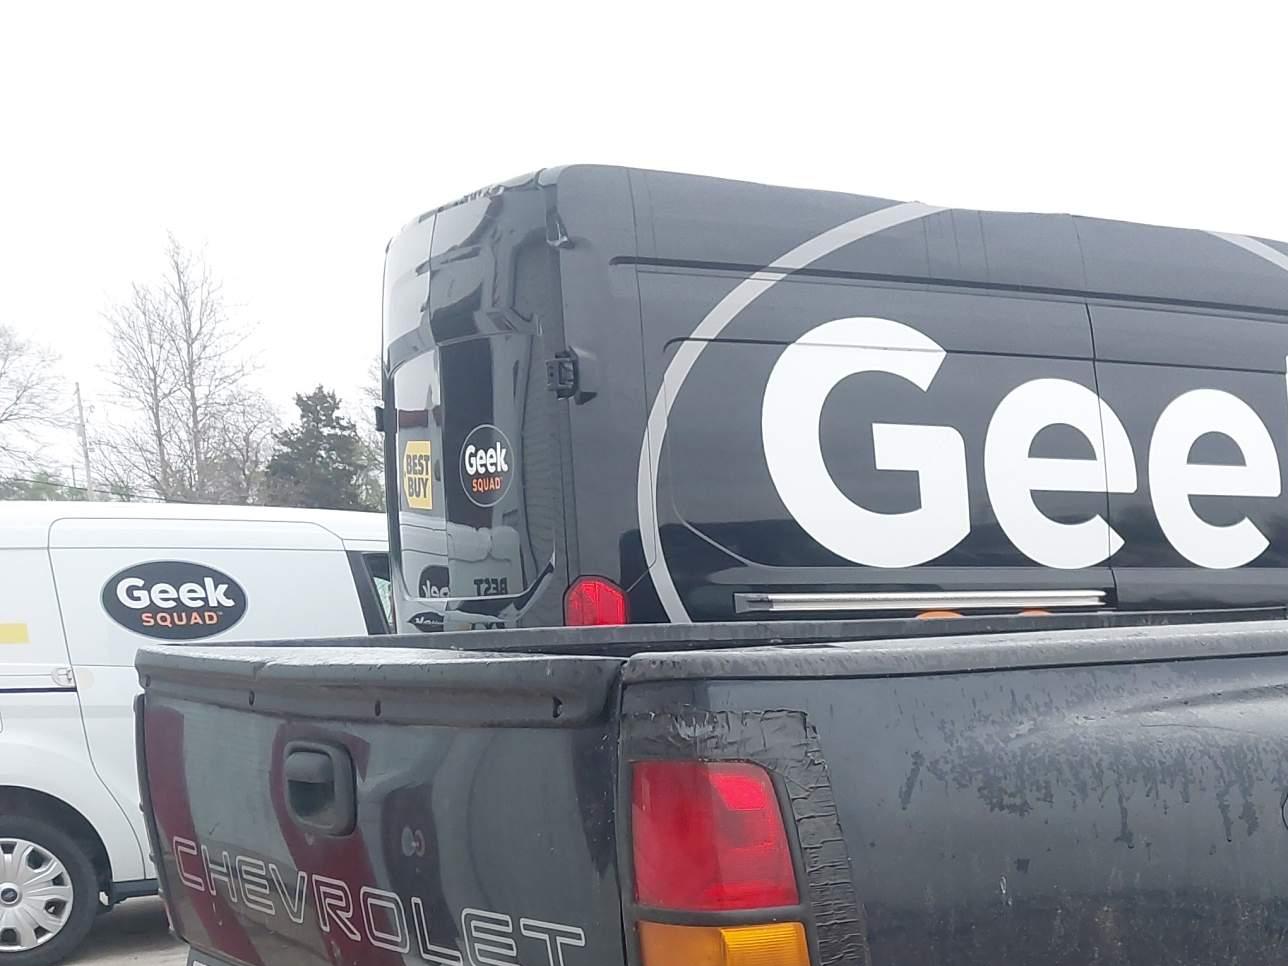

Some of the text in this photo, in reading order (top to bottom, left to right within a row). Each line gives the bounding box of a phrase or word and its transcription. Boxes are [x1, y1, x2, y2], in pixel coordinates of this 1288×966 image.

[406, 454, 430, 475] BEST
[465, 441, 508, 475] Geek
[408, 477, 429, 498] BUY
[472, 477, 501, 492] SQUAD
[116, 577, 235, 609] Geek
[141, 611, 218, 627] SQUAD
